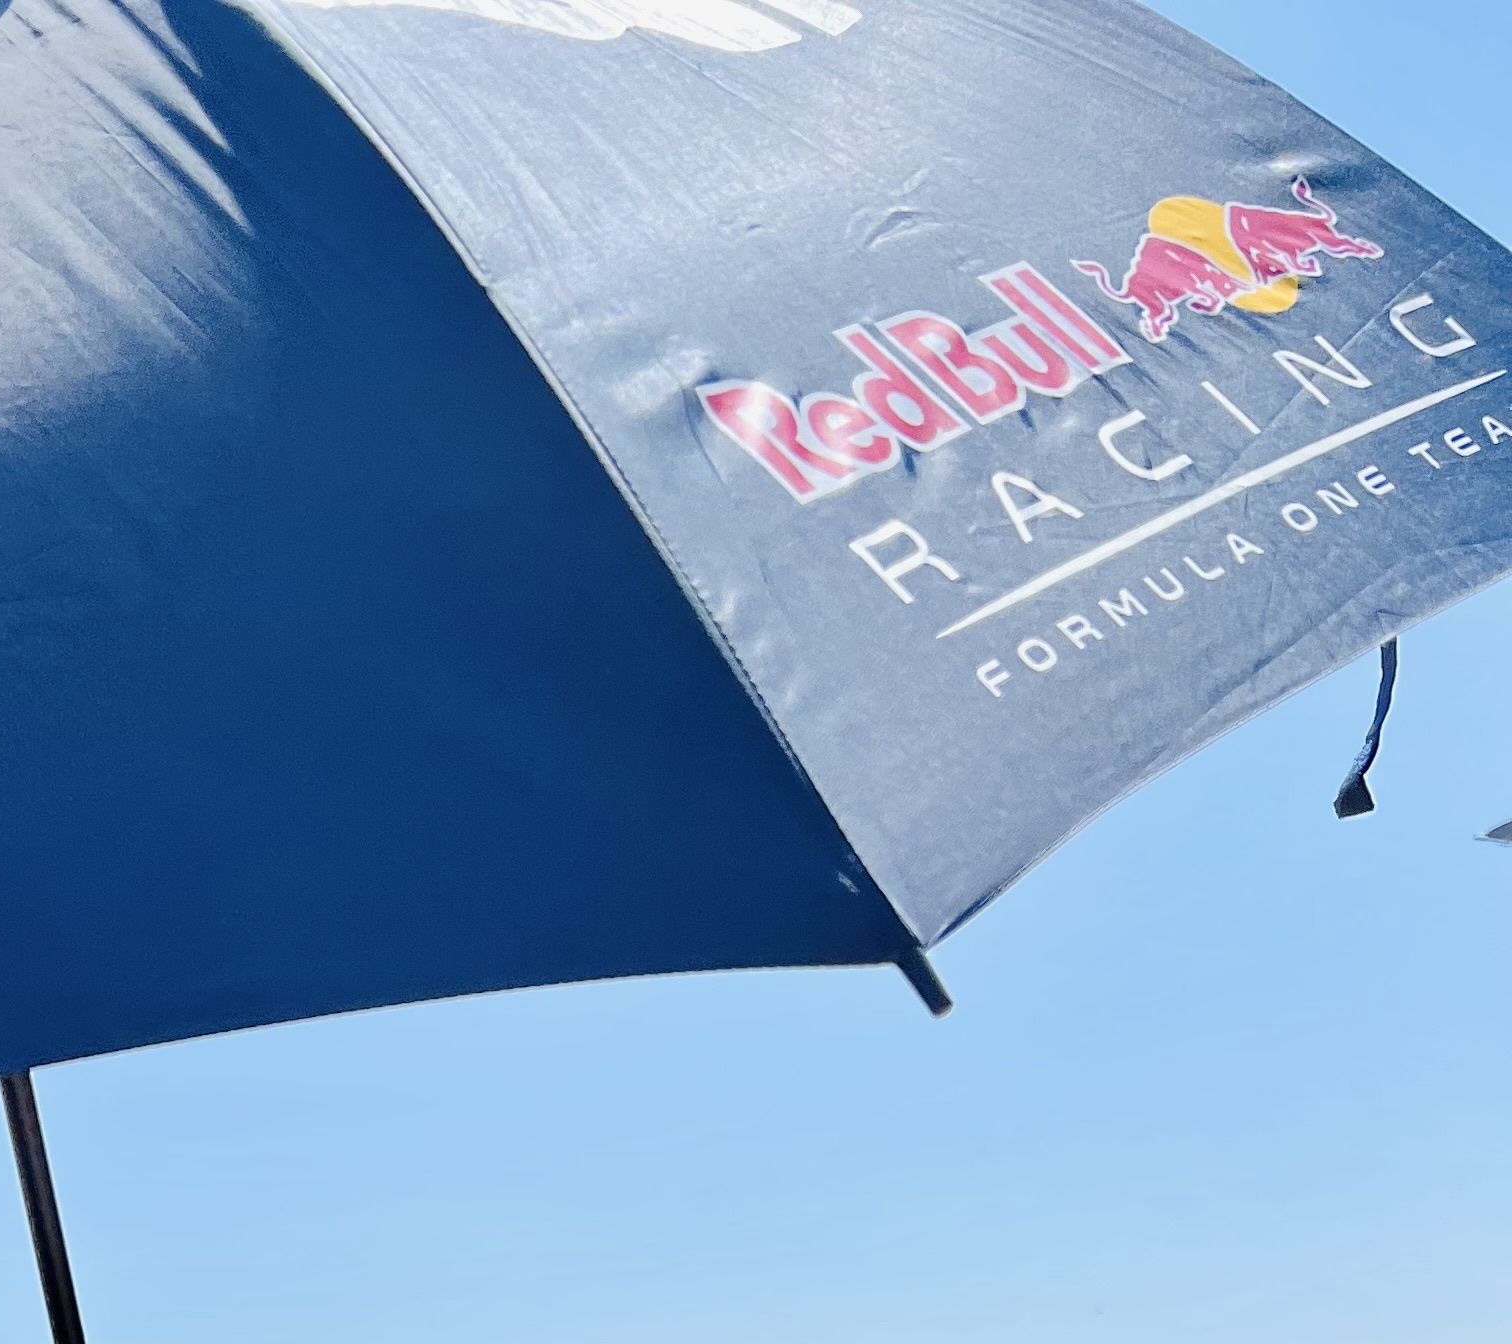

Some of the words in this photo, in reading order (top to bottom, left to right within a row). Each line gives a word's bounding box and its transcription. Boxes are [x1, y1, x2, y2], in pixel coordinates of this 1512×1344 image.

[849, 293, 1476, 604] RACING
[975, 533, 1265, 699] FORMULA
[1281, 464, 1396, 533] ONE
